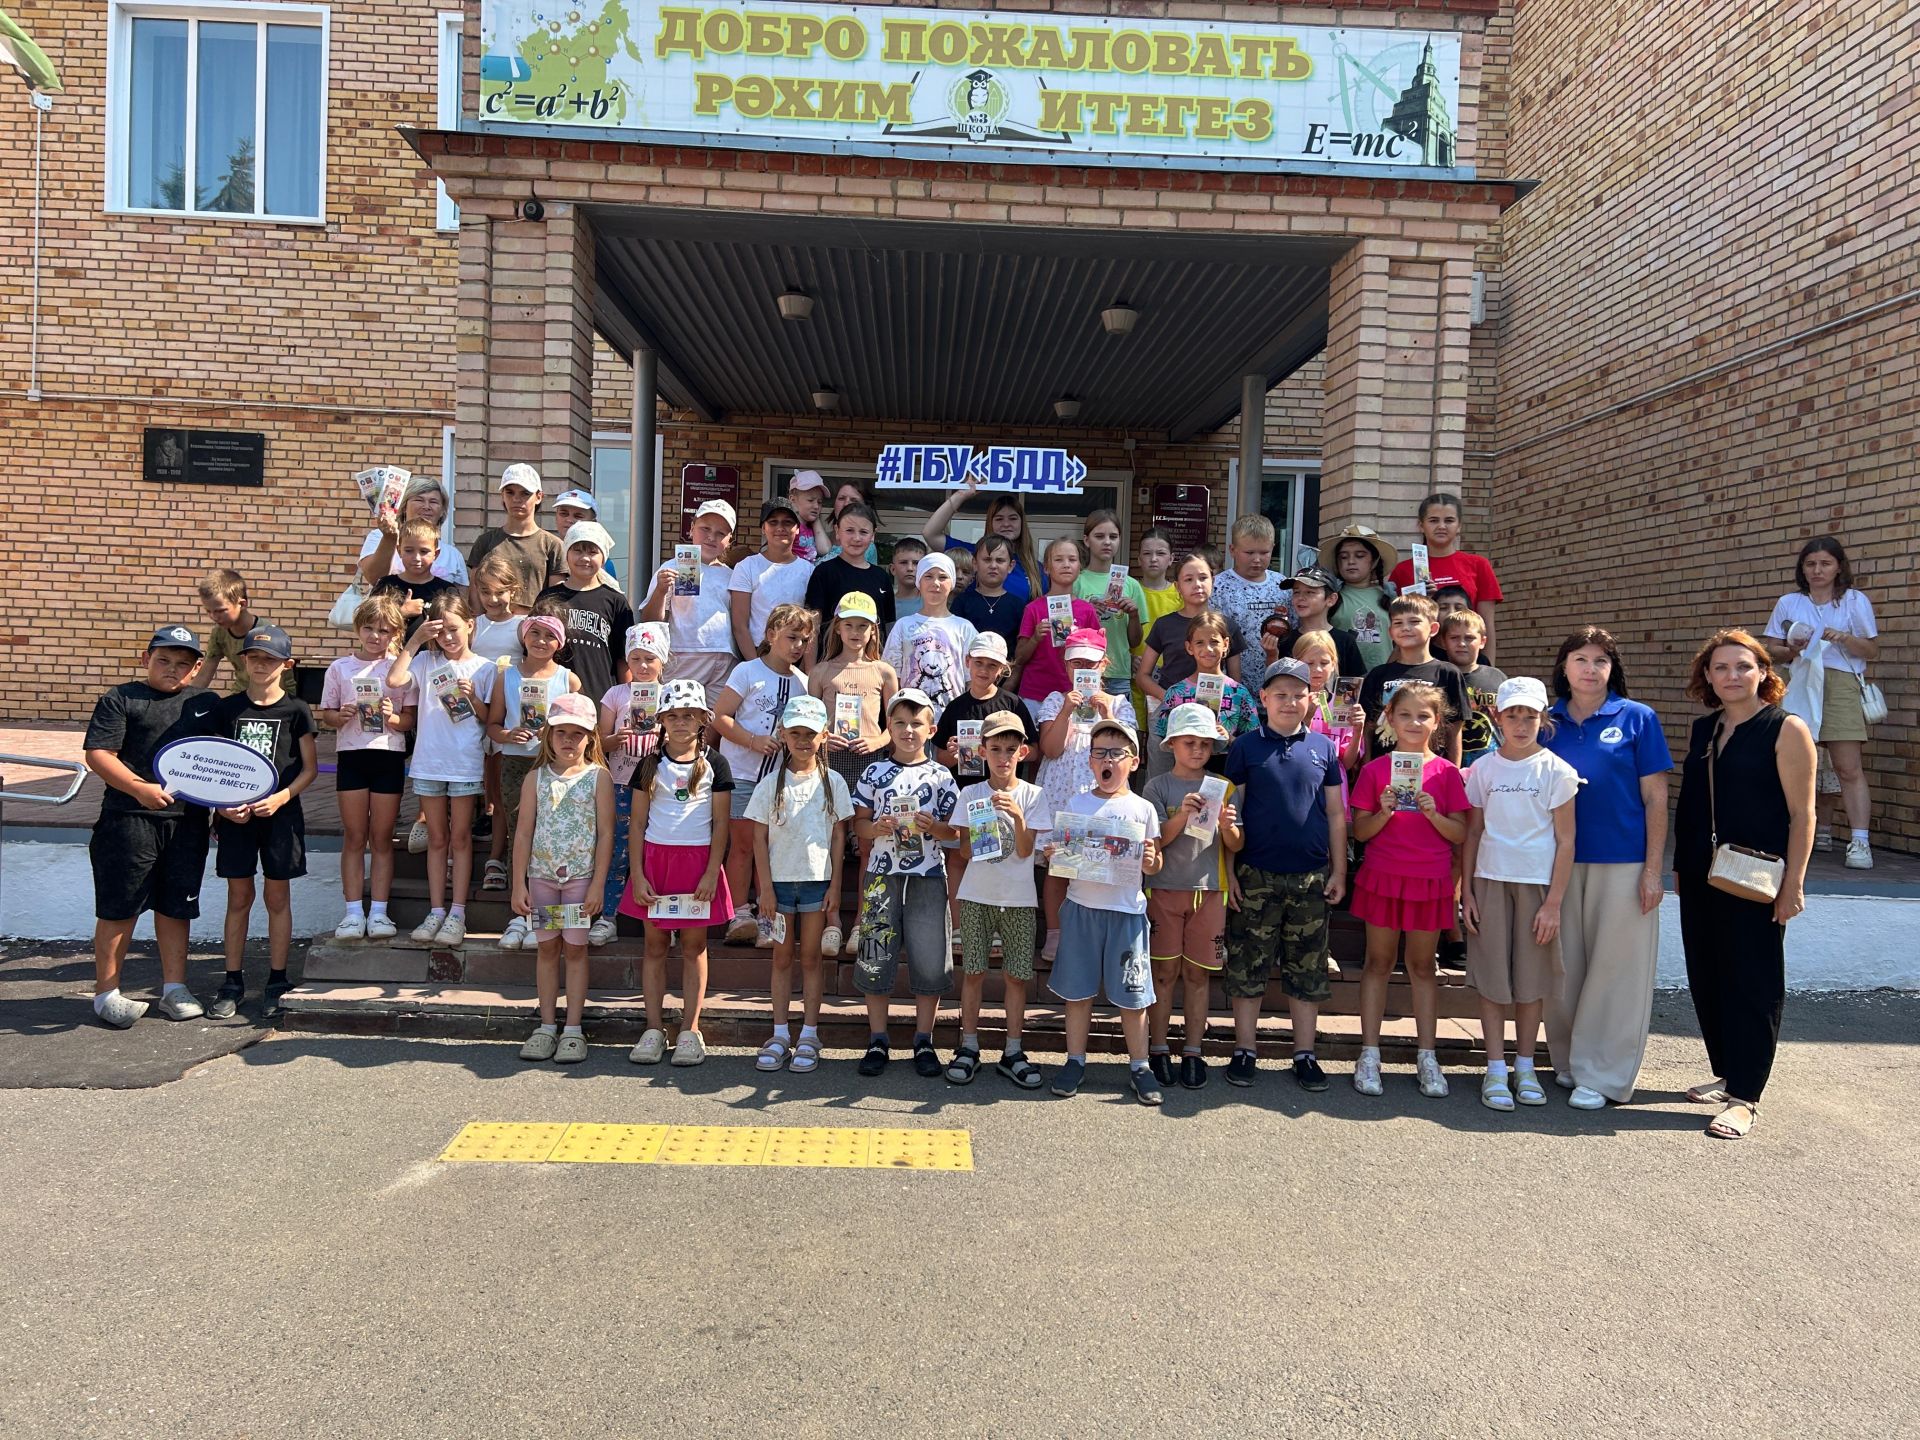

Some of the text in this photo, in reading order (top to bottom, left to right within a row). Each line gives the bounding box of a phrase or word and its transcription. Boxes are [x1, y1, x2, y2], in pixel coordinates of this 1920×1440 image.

[655, 6, 1313, 80] ДОБРО ПОЖАЛОВАТЬ
[694, 73, 1274, 141] РӘХИМ ИТЕГЕЗ
[966, 113, 989, 124] №3
[956, 122, 1000, 135] ШКОЛА
[247, 721, 268, 735] NO
[180, 752, 256, 772] За безопасность
[192, 763, 240, 778] дорожного
[168, 768, 212, 782] движения
[219, 778, 260, 792] ВМЕСТЕ!
